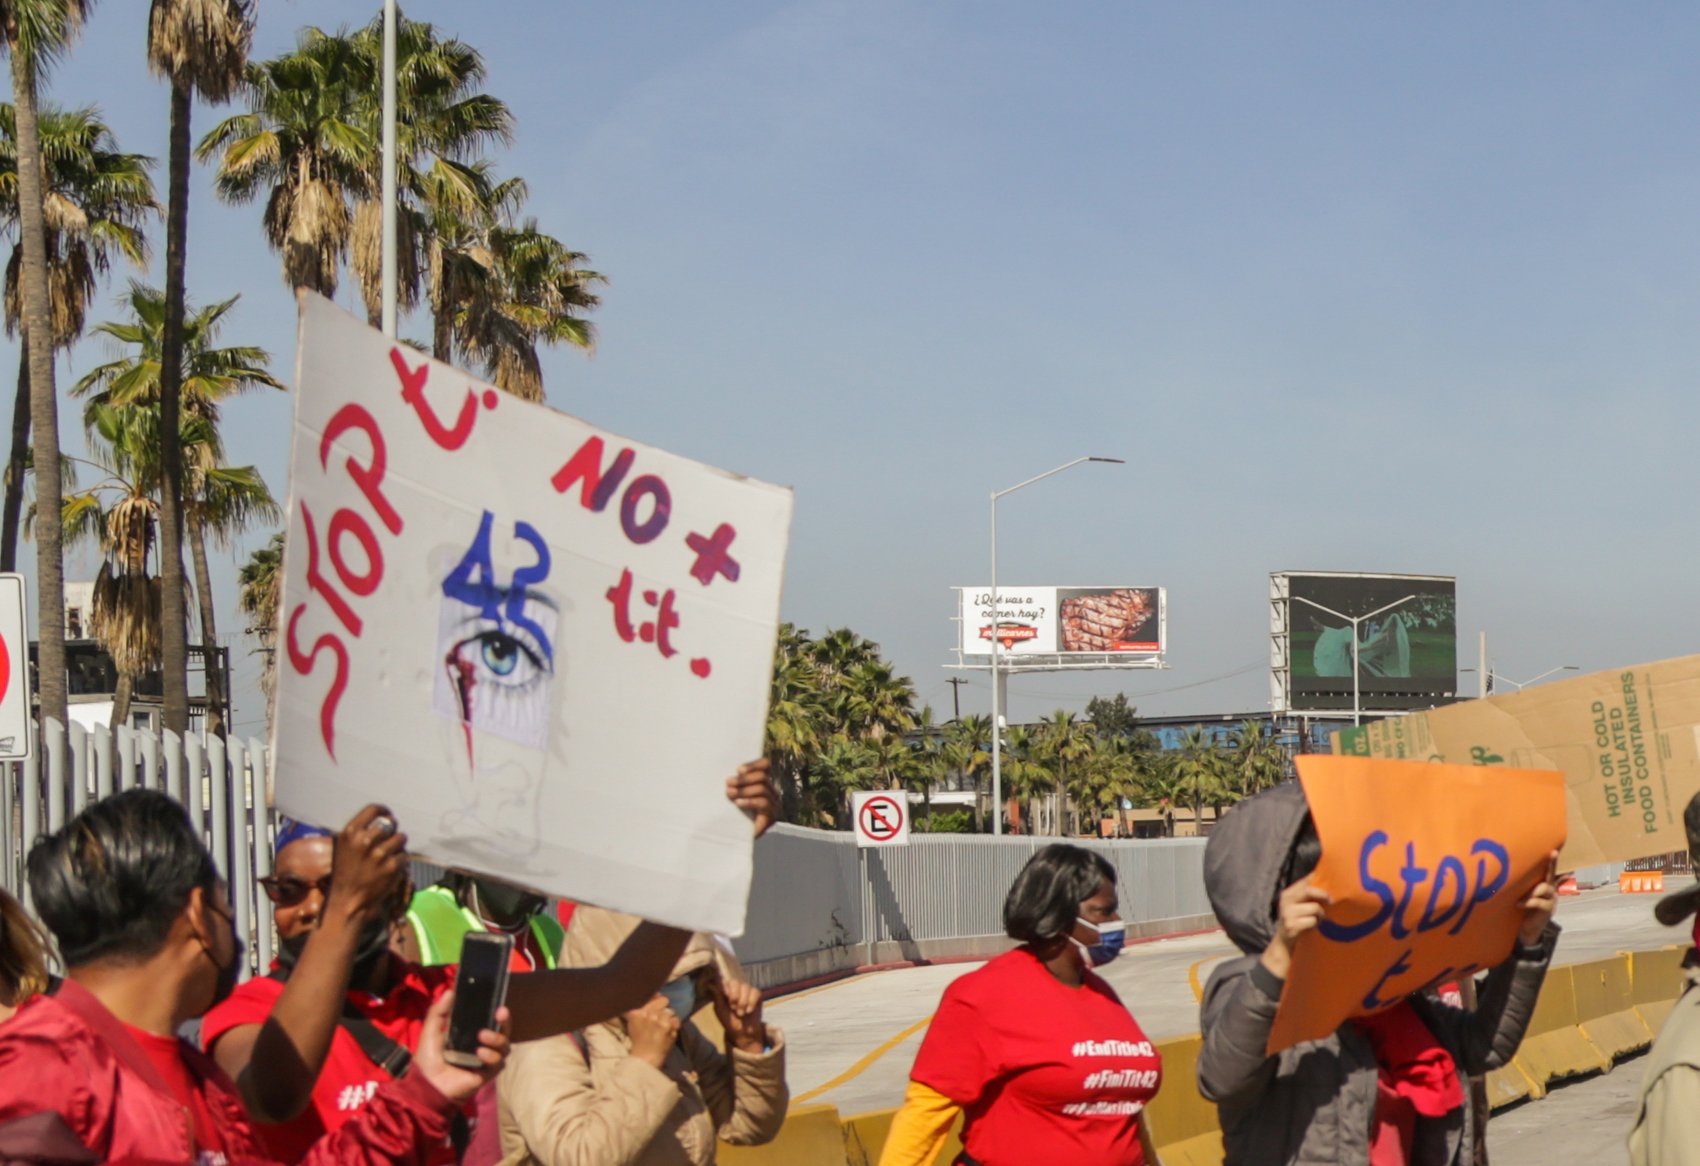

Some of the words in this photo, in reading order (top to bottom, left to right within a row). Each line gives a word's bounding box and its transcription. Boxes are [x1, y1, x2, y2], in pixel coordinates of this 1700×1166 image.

[551, 435, 672, 544] NO
[286, 403, 404, 766] STOP
[441, 510, 554, 662] 42
[1592, 701, 1610, 748] COLD
[1621, 672, 1650, 780] CONTAINERS
[1600, 753, 1615, 777] OR
[1610, 707, 1637, 804] INSULATED
[1604, 784, 1621, 818] HOT
[1639, 786, 1659, 834] FOOD
[1072, 1039, 1155, 1057] #EndTitle42
[1083, 1069, 1159, 1089] #FiniTit42
